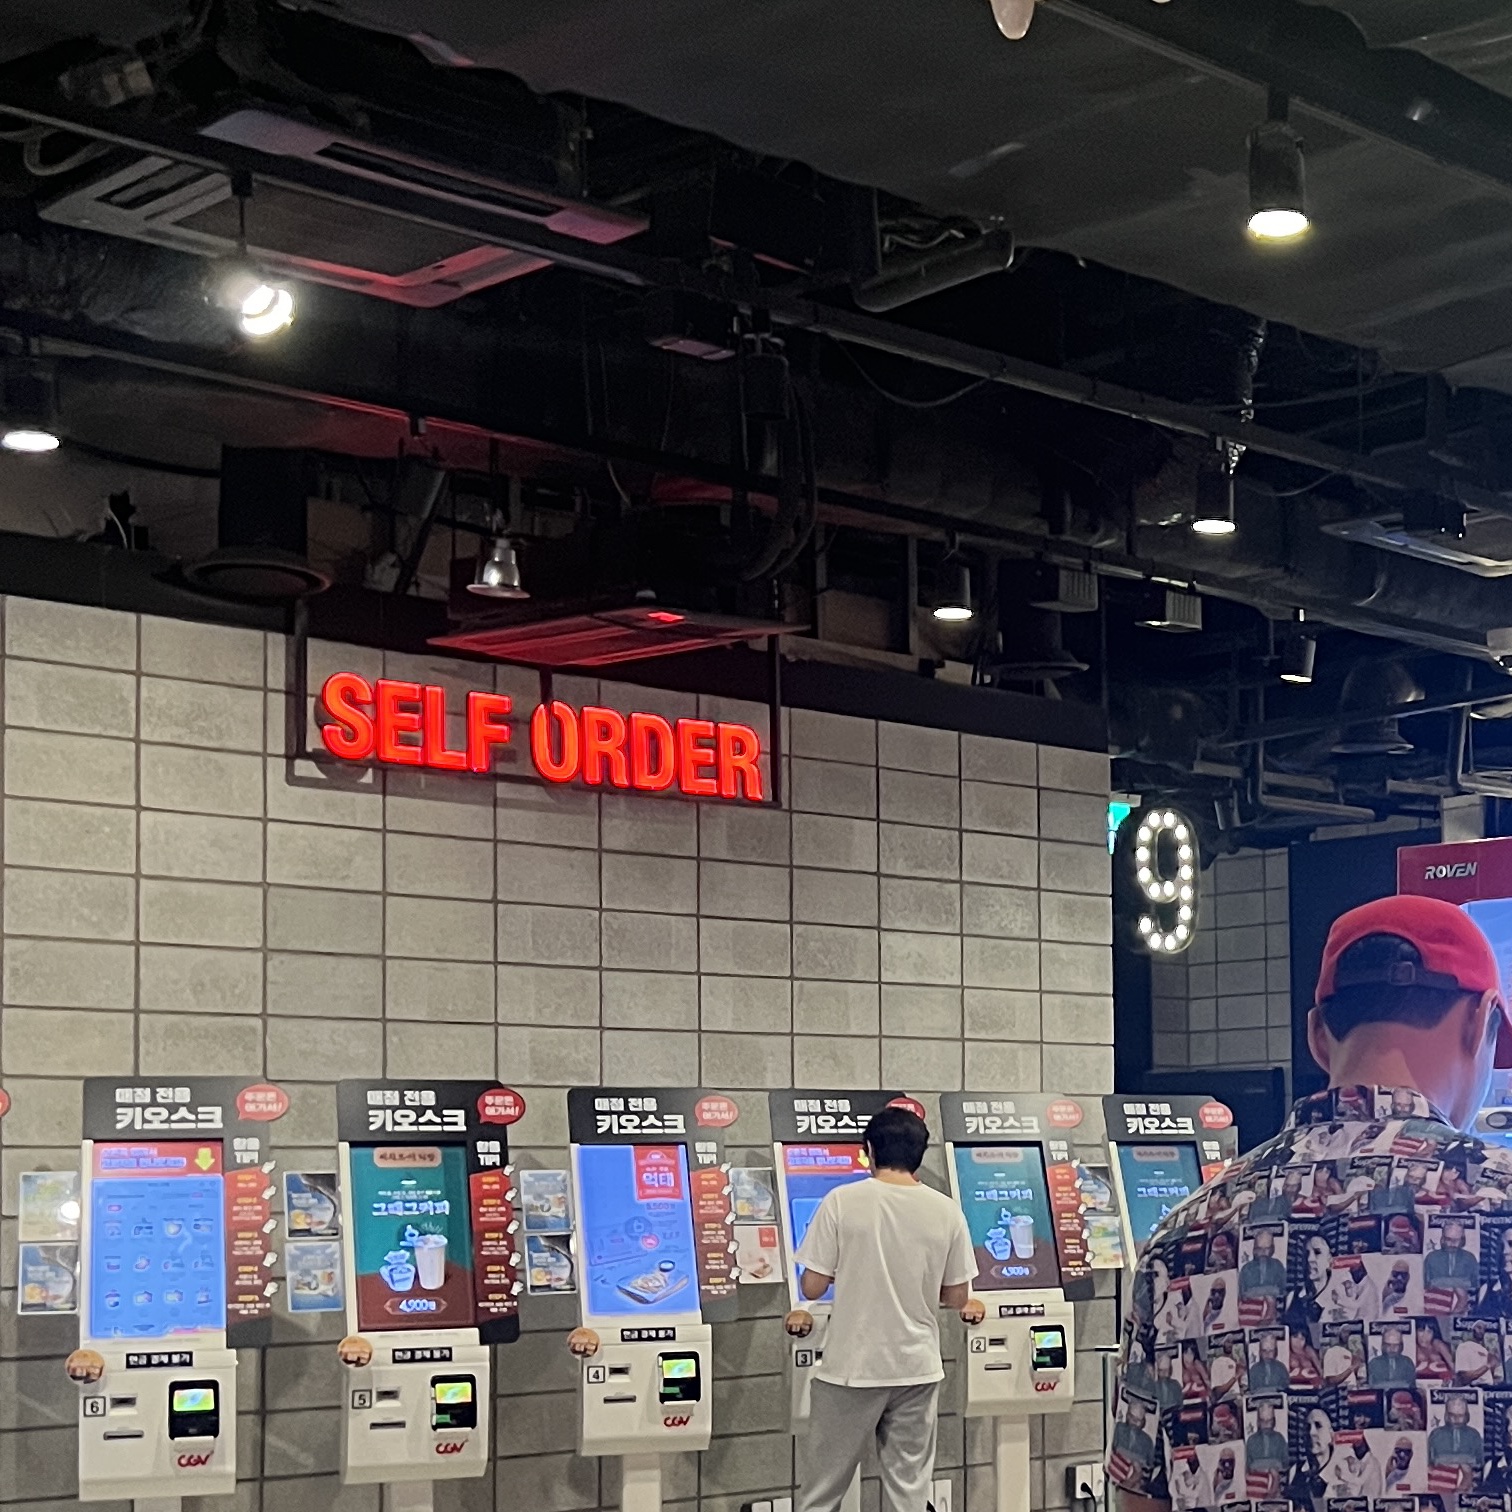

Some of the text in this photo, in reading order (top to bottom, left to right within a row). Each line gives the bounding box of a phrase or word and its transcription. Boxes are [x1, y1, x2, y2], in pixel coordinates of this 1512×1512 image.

[321, 671, 764, 801] SELF ORDER
[1424, 861, 1478, 880] ROVEN
[1136, 808, 1200, 955] 9
[115, 1106, 223, 1130] 키오스크
[368, 1110, 467, 1131] 키오스크
[596, 1115, 686, 1134] 키오스크
[966, 1117, 1040, 1133] 키오스크
[1127, 1117, 1195, 1134] 키오스크
[1479, 1214, 1512, 1226] preme
[975, 1339, 983, 1350] 2
[800, 1353, 808, 1363] 3
[592, 1370, 600, 1381] 4
[357, 1393, 367, 1405] 5
[90, 1402, 100, 1414] 6
[663, 1415, 691, 1428] CGV
[435, 1440, 467, 1455] CGV
[177, 1450, 214, 1467] CGV
